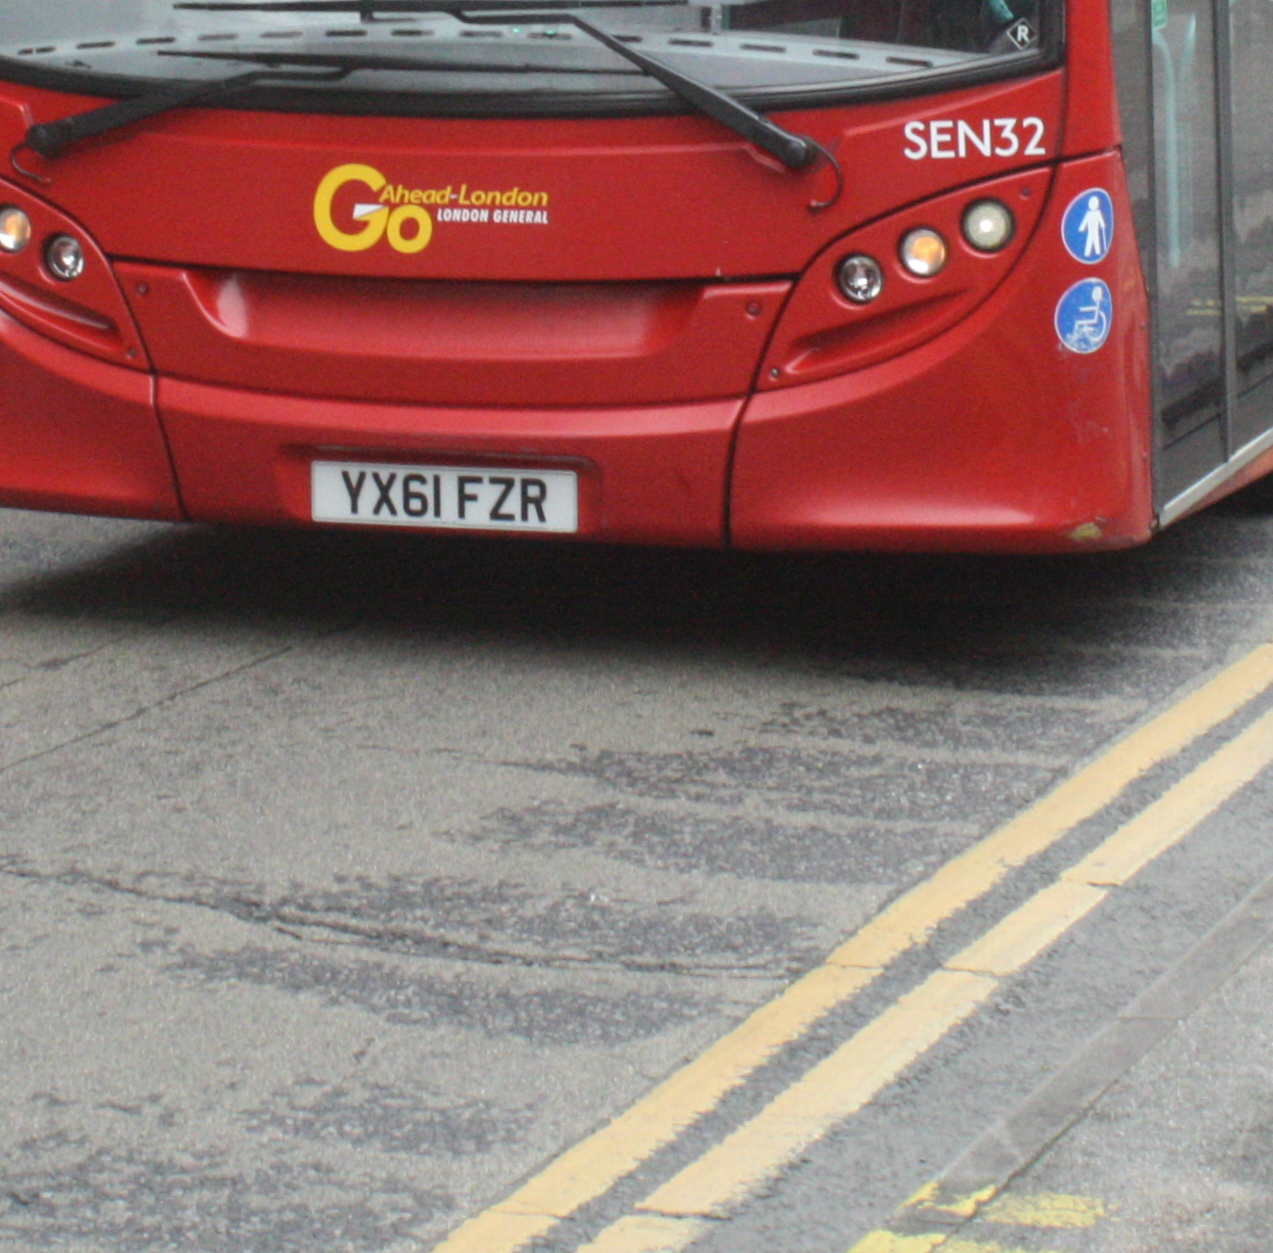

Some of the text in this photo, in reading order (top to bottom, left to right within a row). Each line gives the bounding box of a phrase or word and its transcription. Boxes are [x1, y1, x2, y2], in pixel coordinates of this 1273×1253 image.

[1017, 25, 1030, 44] R
[903, 116, 1046, 160] SEN32
[313, 163, 433, 254] Go
[437, 208, 548, 225] LONDON GENERAL
[341, 470, 547, 523] YX61 FZR
